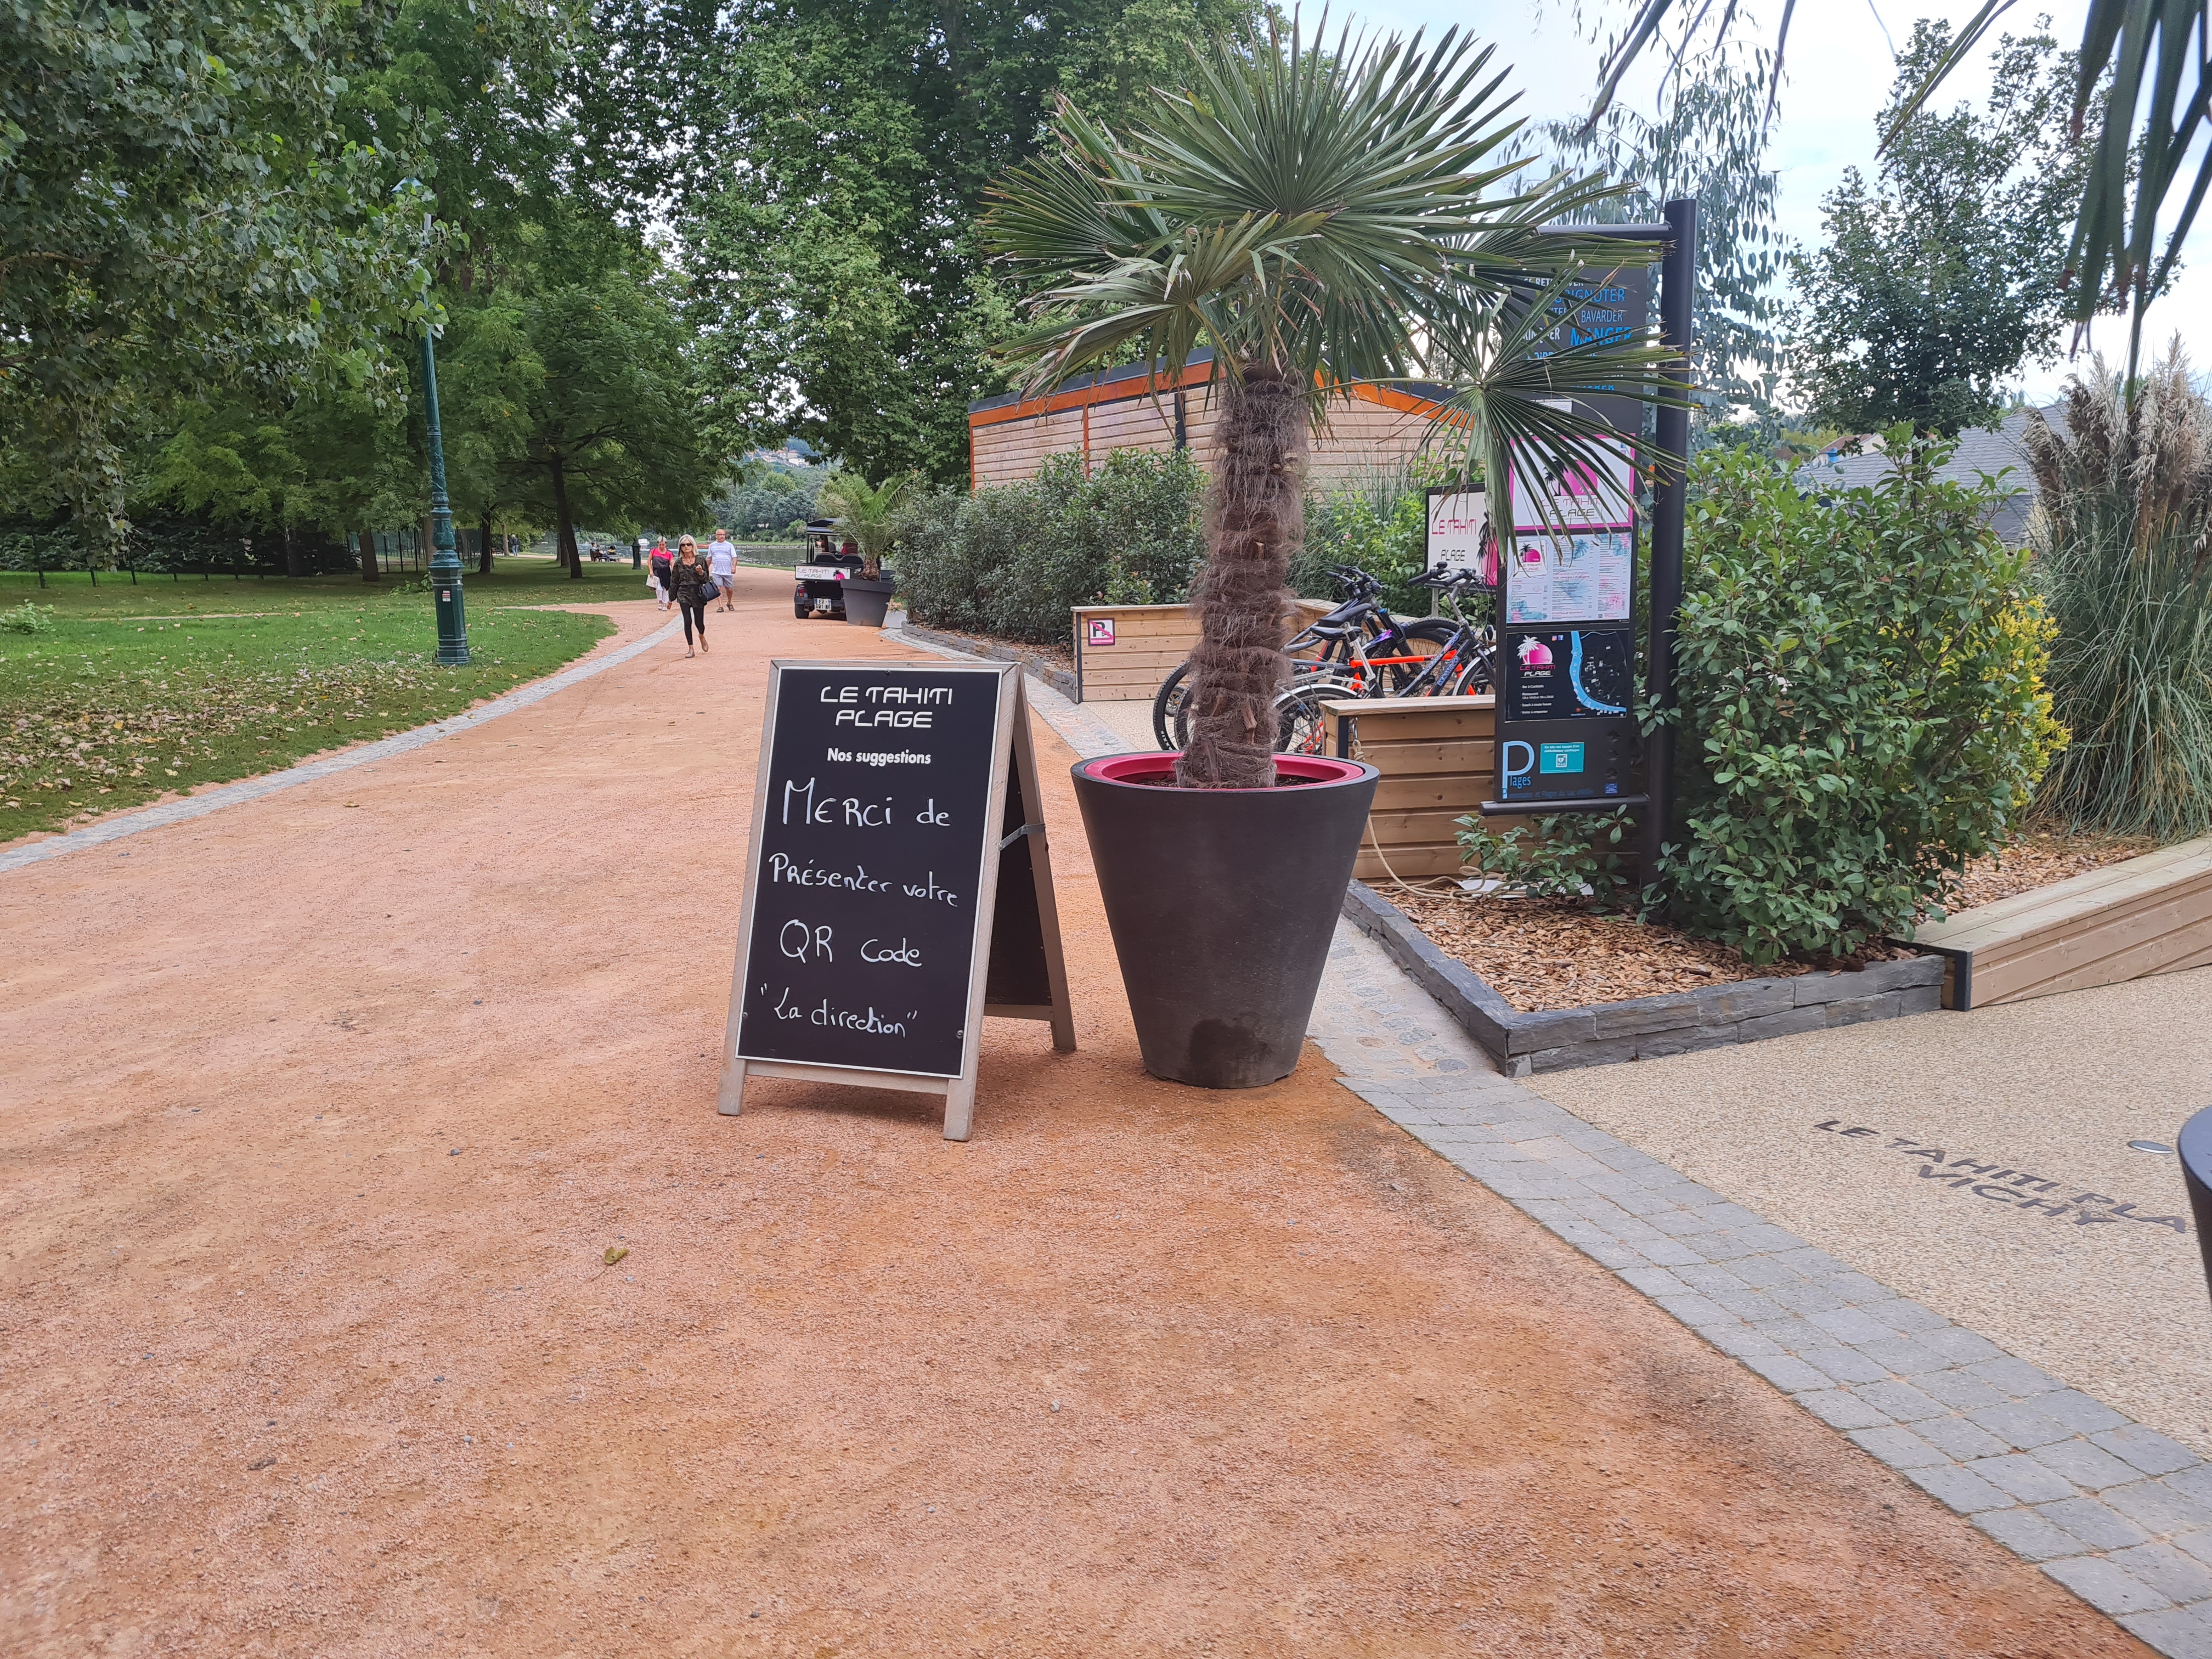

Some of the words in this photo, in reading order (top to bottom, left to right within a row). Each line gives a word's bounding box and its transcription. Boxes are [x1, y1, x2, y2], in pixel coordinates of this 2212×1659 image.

[1581, 309, 1623, 323] BAVARDER
[1432, 520, 1445, 535] LE
[1448, 519, 1476, 535] TAHITI
[1441, 549, 1465, 561] PLAGE
[820, 686, 859, 703] LE
[865, 687, 953, 704] TAHITI
[835, 709, 933, 728] PLAGE
[827, 748, 852, 761] Nos
[856, 749, 931, 766] suggestions
[916, 798, 951, 826] de
[902, 871, 958, 907] votre
[780, 919, 833, 964] QR
[1813, 1120, 1880, 1138] LE
[1884, 1137, 2062, 1192] TAHITI
[1918, 1164, 2119, 1226] VICHY
